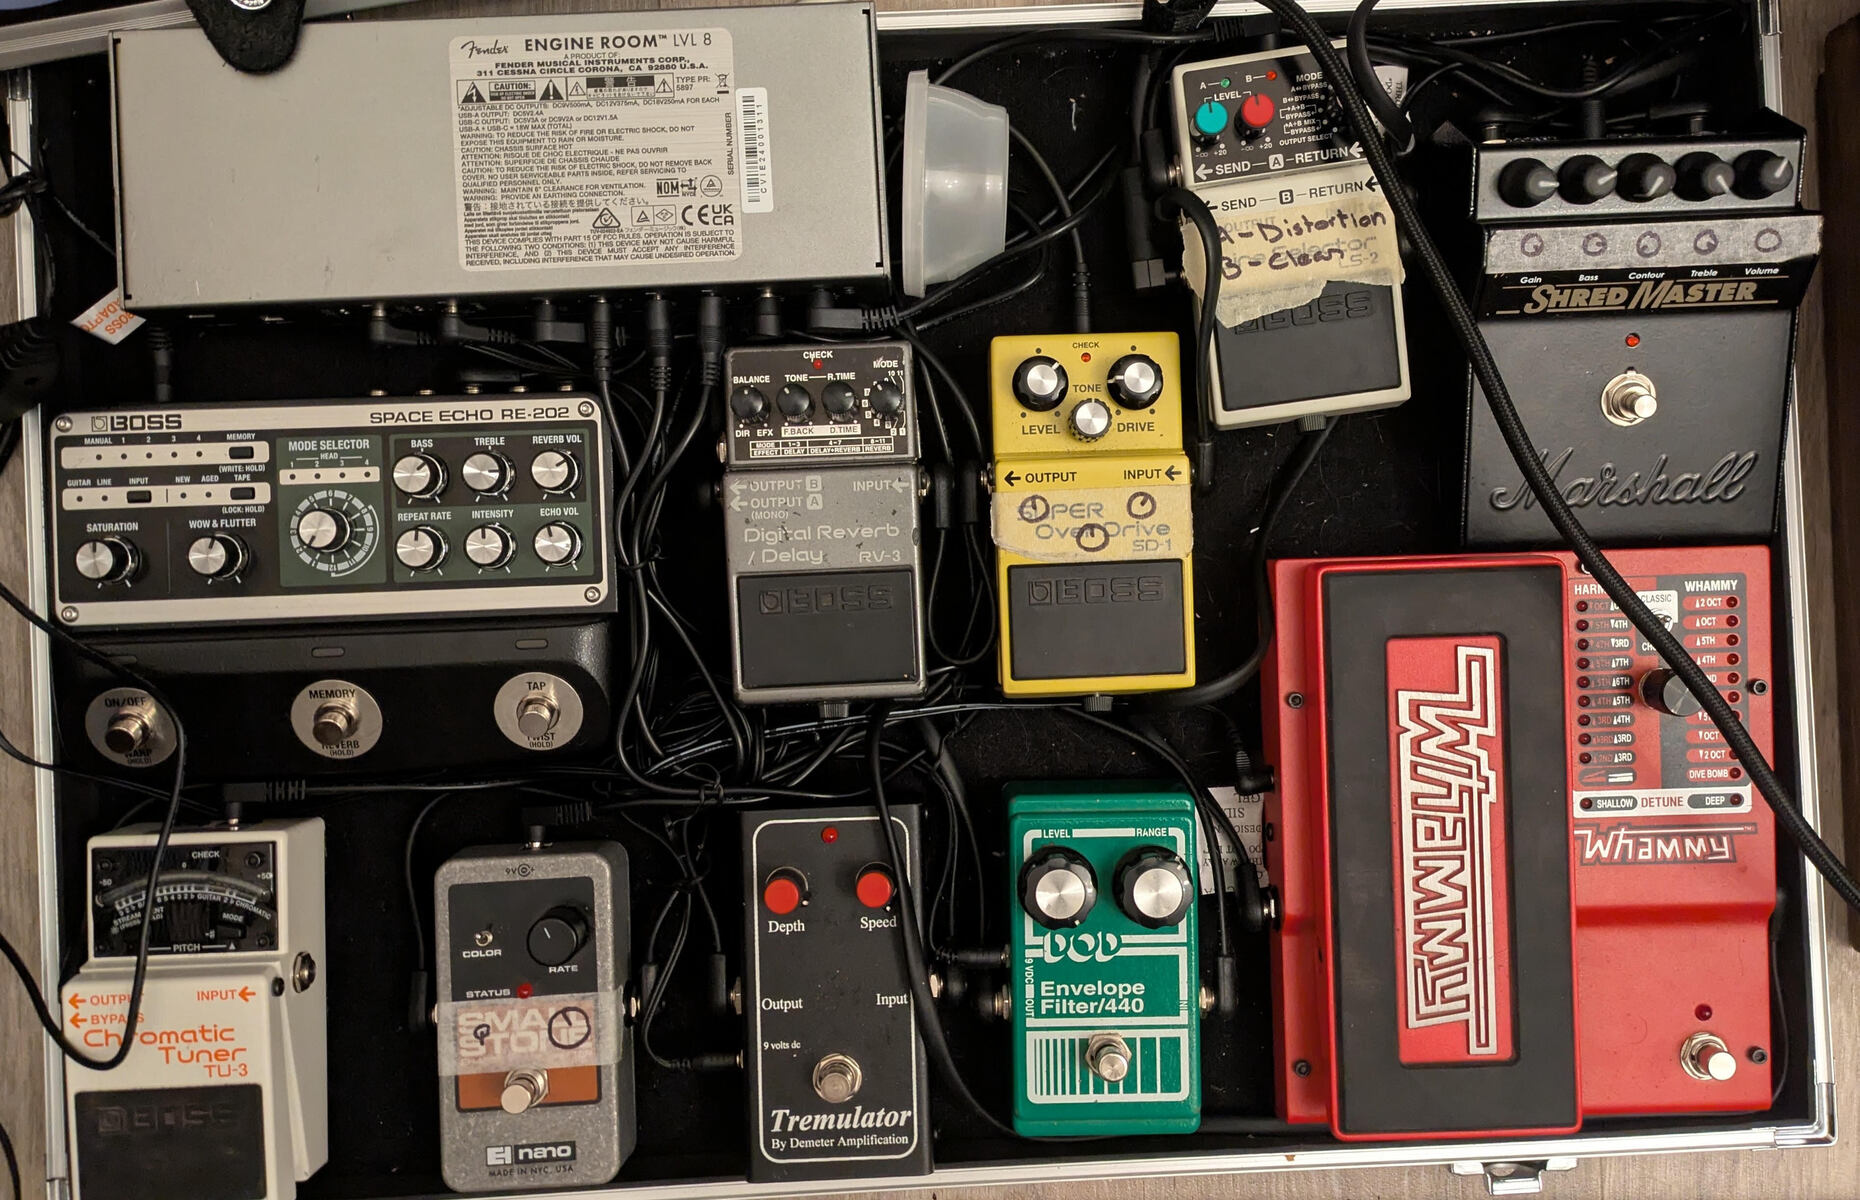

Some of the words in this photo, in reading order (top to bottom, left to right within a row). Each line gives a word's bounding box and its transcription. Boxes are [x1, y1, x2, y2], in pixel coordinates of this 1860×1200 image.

[525, 37, 593, 51] ENGINE
[673, 33, 697, 46] LVL
[703, 33, 711, 46] 8
[460, 40, 508, 58] Fender
[584, 57, 655, 66] INSTRUMENTS
[578, 65, 623, 73] CORONA,
[1296, 72, 1323, 82] MODE
[494, 82, 532, 90] CAUTION:
[1214, 91, 1242, 102] LEVEL
[725, 112, 734, 147] NUMBER
[1279, 136, 1306, 146] OUTPUT
[1307, 133, 1333, 142] SELECT
[727, 147, 735, 176] SERIAL
[1215, 160, 1251, 175] SEND
[1295, 147, 1349, 165] RETURN
[656, 180, 679, 195] NOM
[1221, 197, 1257, 211] SEND
[1309, 181, 1364, 199] RETURN
[711, 204, 733, 214] UK
[712, 215, 735, 226] CA
[1628, 271, 1665, 281] Contour
[1690, 268, 1718, 277] Treble
[1745, 266, 1779, 276] Volume
[1520, 275, 1542, 285] Gain
[1578, 273, 1599, 282] Bass
[1523, 283, 1629, 314] SHRED
[1627, 280, 1758, 310] MASTER
[803, 351, 833, 359] CHECK
[733, 375, 770, 384] BALANCE
[785, 374, 808, 382] TONE
[827, 372, 856, 381] R.TIME
[1073, 384, 1101, 393] TONE
[370, 411, 433, 424] SPACE
[439, 409, 493, 422] ECHO
[501, 407, 569, 420] RE-202
[110, 414, 182, 430] BOSS
[1118, 422, 1155, 432] DRIVE
[735, 430, 750, 438] DIR
[757, 429, 773, 437] EFX
[783, 427, 814, 435] F.BACK
[830, 425, 858, 434] D.TIME
[1022, 425, 1060, 435] LEVEL
[84, 437, 112, 445] MANUAL
[226, 433, 256, 441] MEMORY
[288, 441, 318, 451] MODE
[320, 439, 370, 450] SELECTOR
[411, 439, 433, 448] BASS
[474, 437, 505, 446] TREBLE
[532, 435, 564, 445] REVERB
[565, 434, 582, 443] VOL
[320, 452, 338, 460] HEAD
[219, 465, 244, 473] (WRITE:
[245, 464, 266, 472] HOLD)
[67, 479, 91, 487] GUITAR
[97, 478, 112, 486] LINE
[129, 477, 149, 485] INPUT
[175, 475, 191, 484] NEW
[201, 474, 219, 483] AGED
[234, 473, 251, 482] TAPE
[1025, 472, 1077, 483] OUTPUT
[1124, 469, 1161, 480] INPUT
[1490, 447, 1758, 511] Marshall
[750, 480, 802, 492] OUTPUT
[853, 480, 891, 491] INPUT
[751, 496, 803, 508] OUTPUT
[222, 505, 244, 514] (LOCK:
[245, 505, 265, 513] HOLD)
[397, 512, 429, 521] REPEAT
[430, 511, 452, 520] RATE
[471, 509, 514, 519] INTENSITY
[540, 507, 561, 517] ECHO
[562, 506, 579, 516] VOL
[751, 511, 789, 521] (MONO)
[86, 522, 138, 532] SATURATION
[189, 519, 211, 529] WOW
[220, 518, 256, 528] FLUTTER
[744, 526, 811, 545] Digital
[817, 523, 899, 539] Reverb
[1133, 538, 1172, 551] SD-1
[762, 549, 824, 565] Delay
[859, 550, 901, 563] RV-3
[1685, 580, 1738, 592] WHAMMY
[1641, 594, 1671, 603] CLASSIC
[1702, 636, 1715, 645] 5TH
[527, 681, 546, 691] TAP
[309, 689, 356, 699] MEMORY
[104, 697, 146, 707] ON/OFF
[1690, 770, 1706, 778] DIVE
[1707, 769, 1728, 777] BOMB
[1597, 799, 1633, 808] SHALLOW
[1641, 797, 1684, 807] DETUNE
[1705, 796, 1725, 805] DEEP
[1043, 829, 1071, 839] LEVEL
[1136, 827, 1167, 837] RANGE
[191, 851, 220, 859] CHECK
[235, 901, 272, 920] CHROMATIC
[222, 912, 244, 922] MODE
[768, 919, 806, 935] Depth
[860, 916, 897, 931] Speed
[173, 943, 201, 953] PITCH
[463, 949, 502, 958] COLOR
[548, 964, 579, 973] RATE
[1024, 966, 1034, 984] VDC
[196, 989, 237, 1001] INPUT
[466, 988, 511, 998] STATUS
[1040, 981, 1146, 1000] Envelope
[762, 997, 803, 1012] Output
[876, 993, 908, 1008] Input
[1040, 998, 1145, 1014] Filter/440
[1025, 998, 1035, 1018] OUT
[91, 1013, 144, 1025] BYPAS
[83, 1024, 235, 1047] Chomatic
[771, 1040, 789, 1050] volts
[791, 1040, 801, 1049] dc
[158, 1046, 247, 1064] Tuner
[204, 1064, 248, 1078] TU-3
[770, 1106, 912, 1133] Tremulator
[771, 1137, 787, 1150] By
[790, 1136, 834, 1148] Demeter
[837, 1133, 909, 1148] Amplification
[518, 1145, 572, 1161] nano
[489, 1167, 514, 1177] MADE
[555, 1164, 574, 1174] USA
